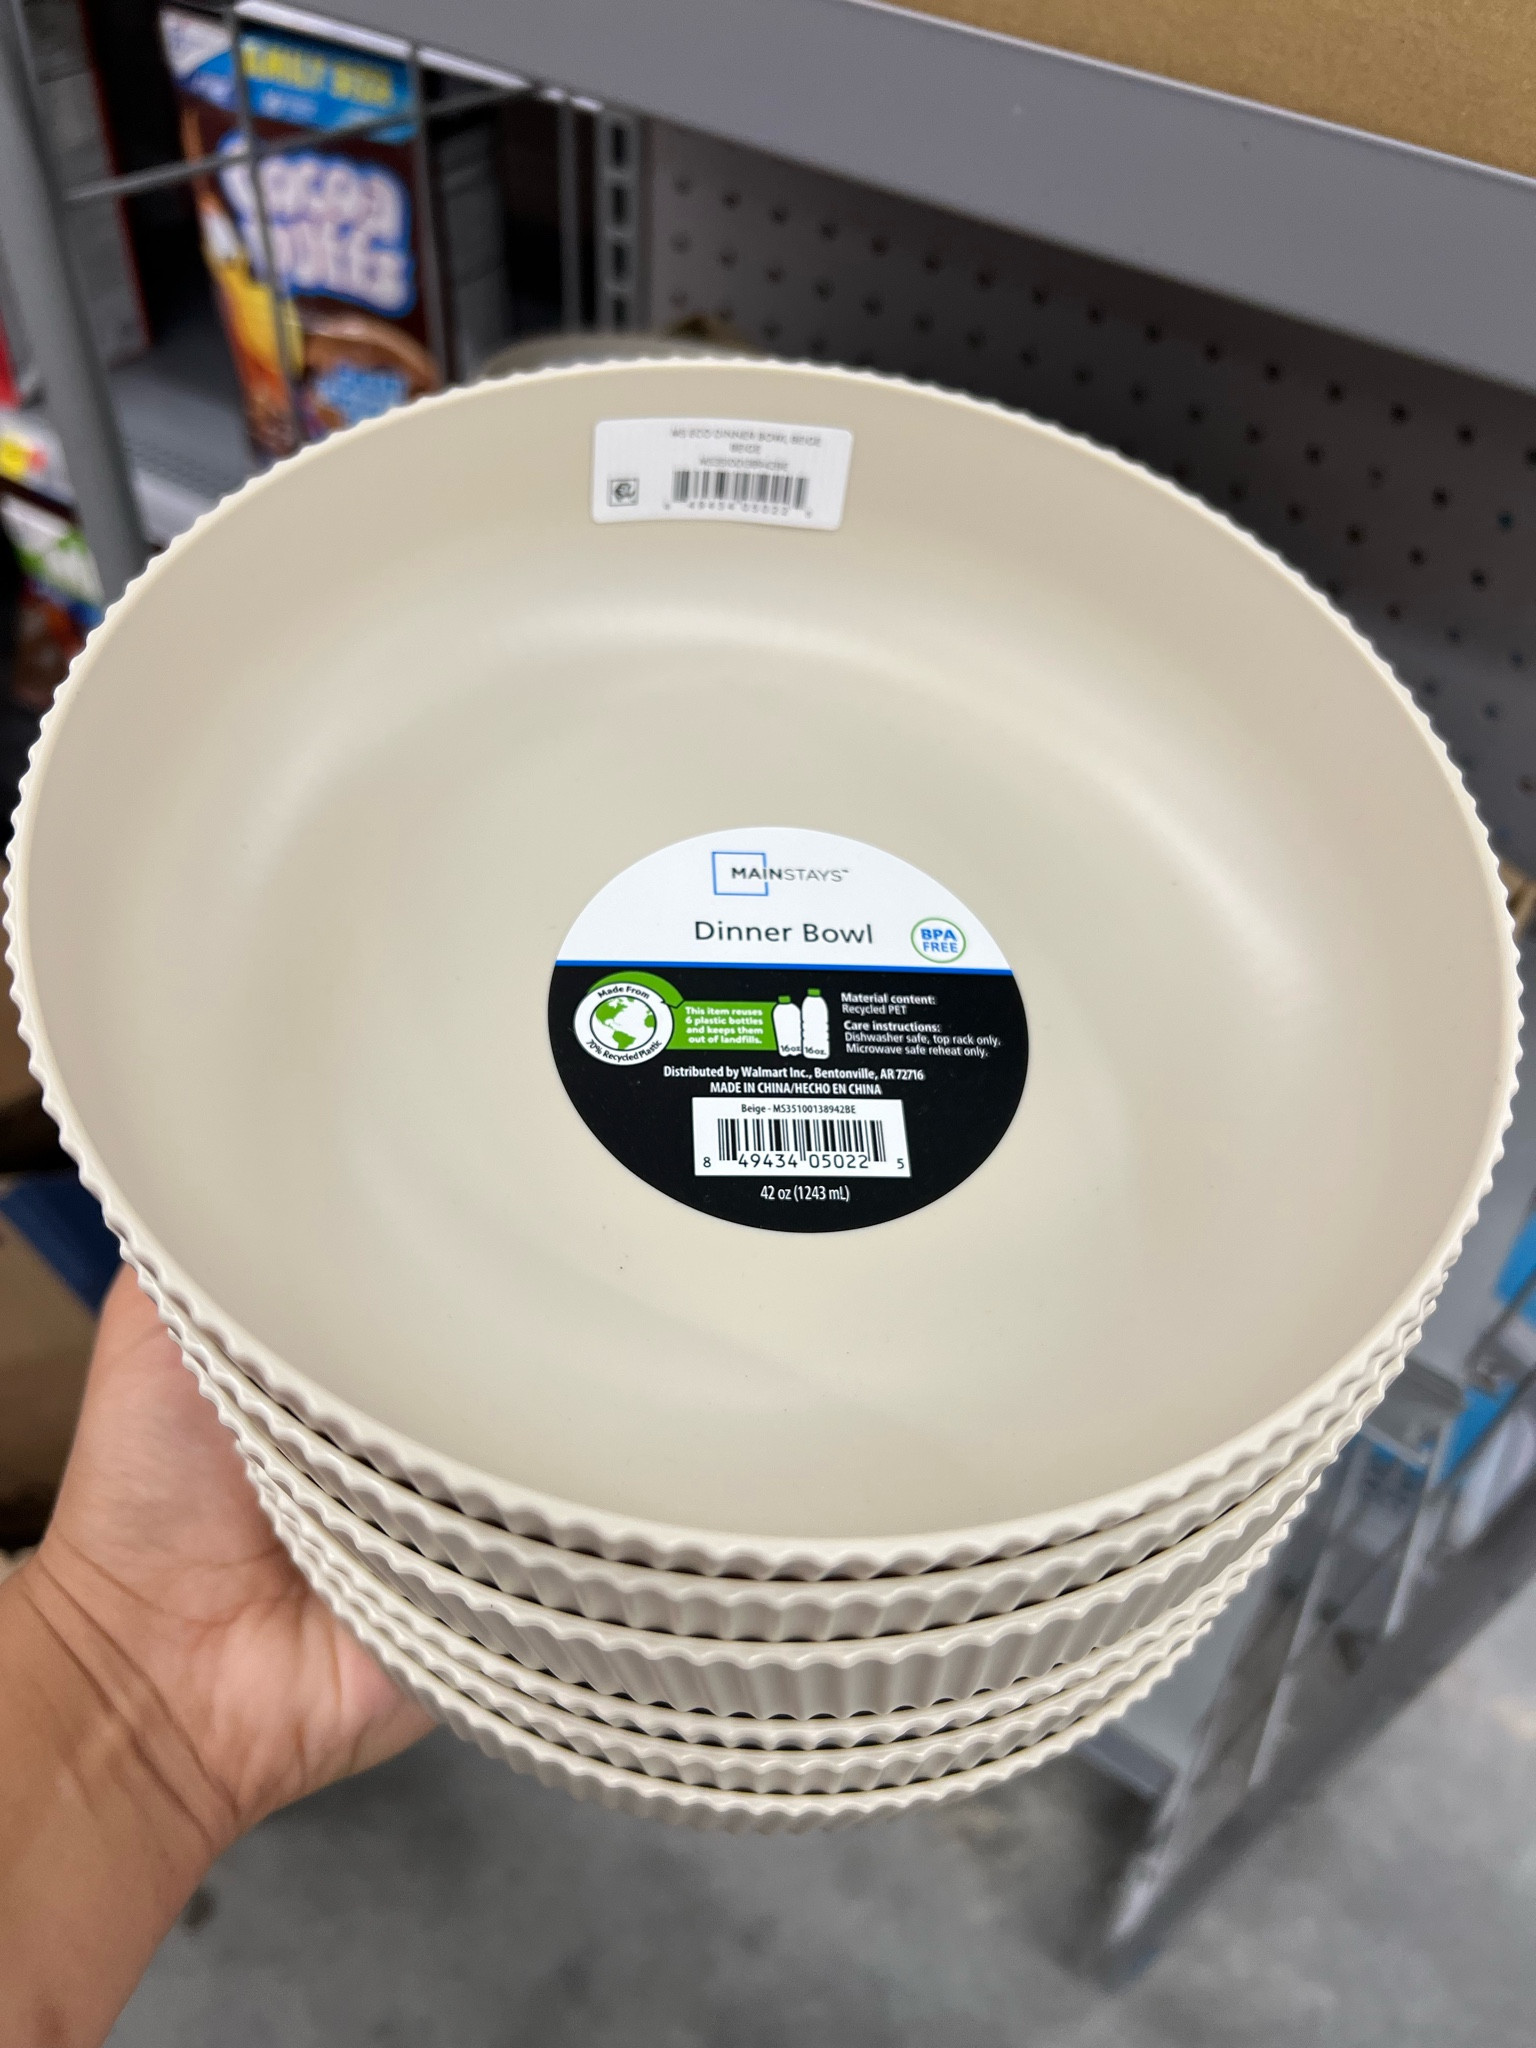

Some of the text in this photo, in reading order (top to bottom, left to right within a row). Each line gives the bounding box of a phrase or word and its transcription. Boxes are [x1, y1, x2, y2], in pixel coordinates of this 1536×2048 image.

[695, 921, 873, 944] Dinner Bowl
[921, 928, 957, 941] BPA
[923, 942, 958, 953] FREE
[597, 986, 650, 999] Made From
[841, 992, 936, 1005] Material content:
[685, 1006, 763, 1016] This item reuses
[842, 1004, 907, 1016] Recycled PET
[685, 1016, 763, 1026] 6 plastic bottles
[844, 1020, 941, 1032] Care instructions:
[686, 1026, 763, 1036] and keeps them
[688, 1035, 762, 1044] out of landfills.
[845, 1032, 1001, 1047] Dishwasher safe, top rack only.
[586, 1039, 662, 1062] 70% Recycled Plastic
[846, 1043, 988, 1058] Microwave safe reheat only.
[663, 1065, 924, 1080] Distributed by Walmart Inc., Bentonville, AR 72716
[710, 1082, 882, 1095] MADE IN CHINA/HECHO EN CHINA
[741, 1104, 766, 1114] Beige
[773, 1104, 856, 1114] MS35100138942BE
[703, 1153, 905, 1169] 8 49434 05022 5
[760, 1185, 850, 1202] 42 oz (1243 mL)
